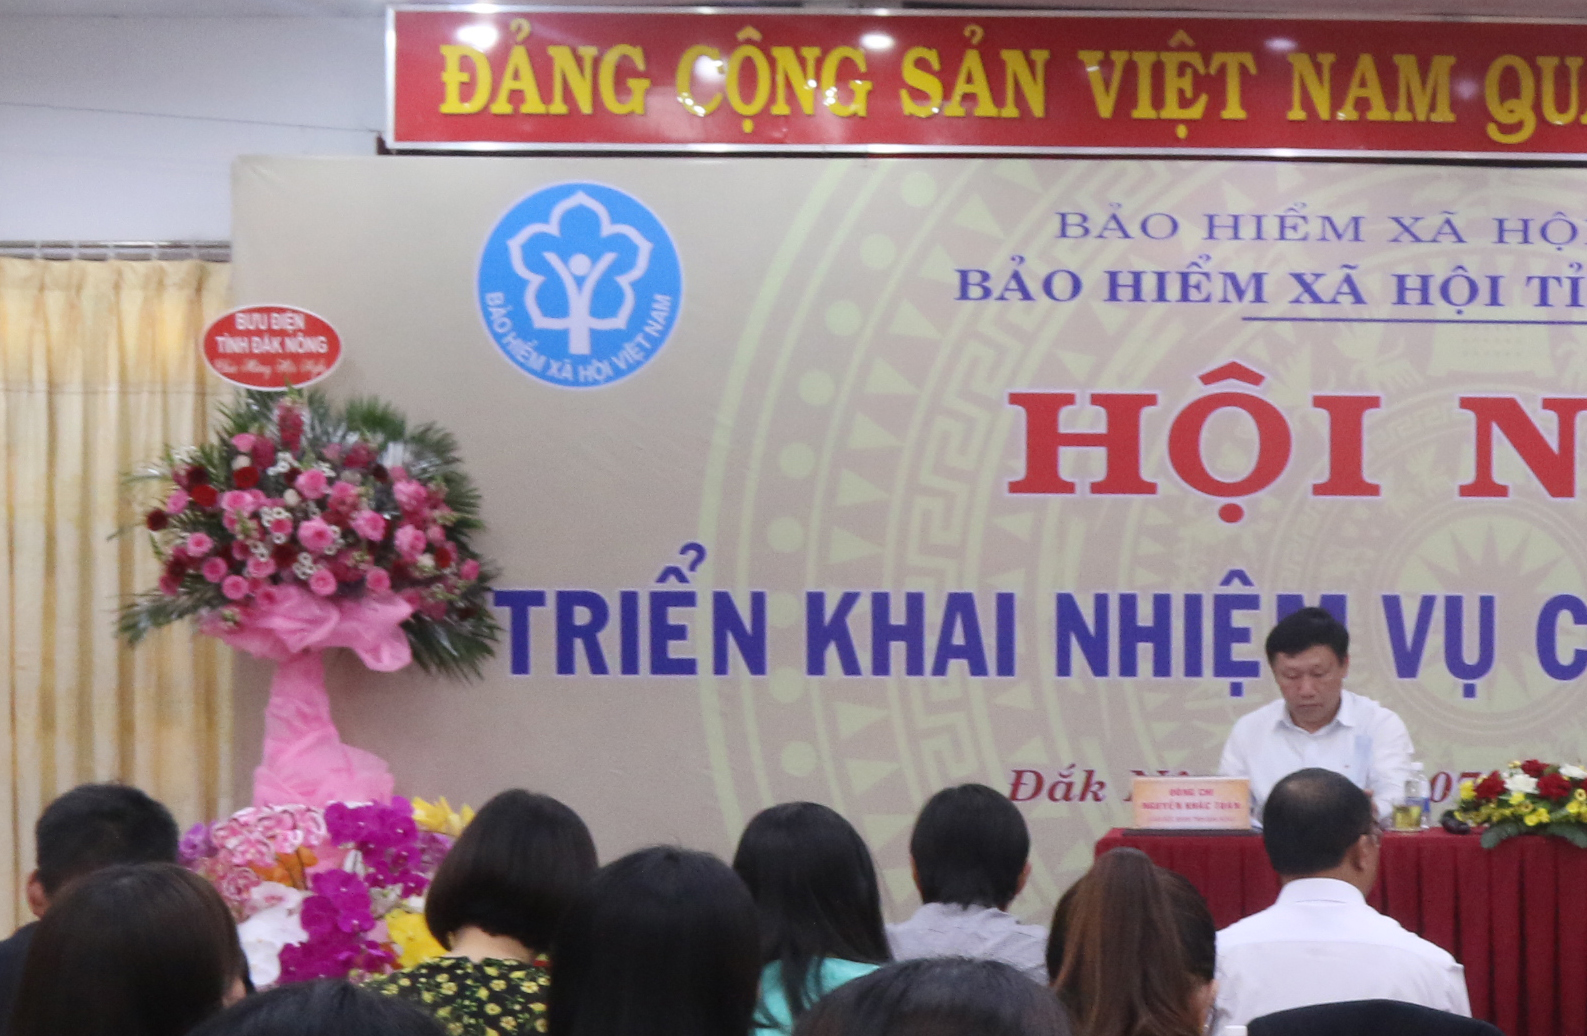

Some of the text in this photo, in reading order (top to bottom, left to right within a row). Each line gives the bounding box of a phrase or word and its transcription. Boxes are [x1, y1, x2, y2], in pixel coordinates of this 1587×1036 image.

[440, 18, 650, 115] ĐẢNG
[675, 25, 872, 134] CỘNG
[900, 23, 1049, 118] SẢN
[1077, 29, 1257, 139] VIỆT
[1286, 52, 1456, 122] NAM
[1054, 202, 1180, 240] BẢO
[1202, 202, 1367, 243] HIỂM
[1388, 211, 1468, 244] XÃ
[954, 255, 1084, 302] BẢO
[1102, 254, 1269, 304] HIỂM
[1288, 265, 1368, 306] XÃ
[1391, 265, 1506, 315] HỘI
[485, 291, 672, 382] BẢO HIỂM XÃ HỘI VIỆT NAM
[1007, 361, 1382, 524] HỘI
[493, 542, 767, 676] TRIỂN
[806, 591, 1016, 677] KHAI
[1056, 569, 1347, 697] NHIỆ
[1381, 594, 1496, 698] VỤ
[1008, 763, 1107, 802] Đắk
